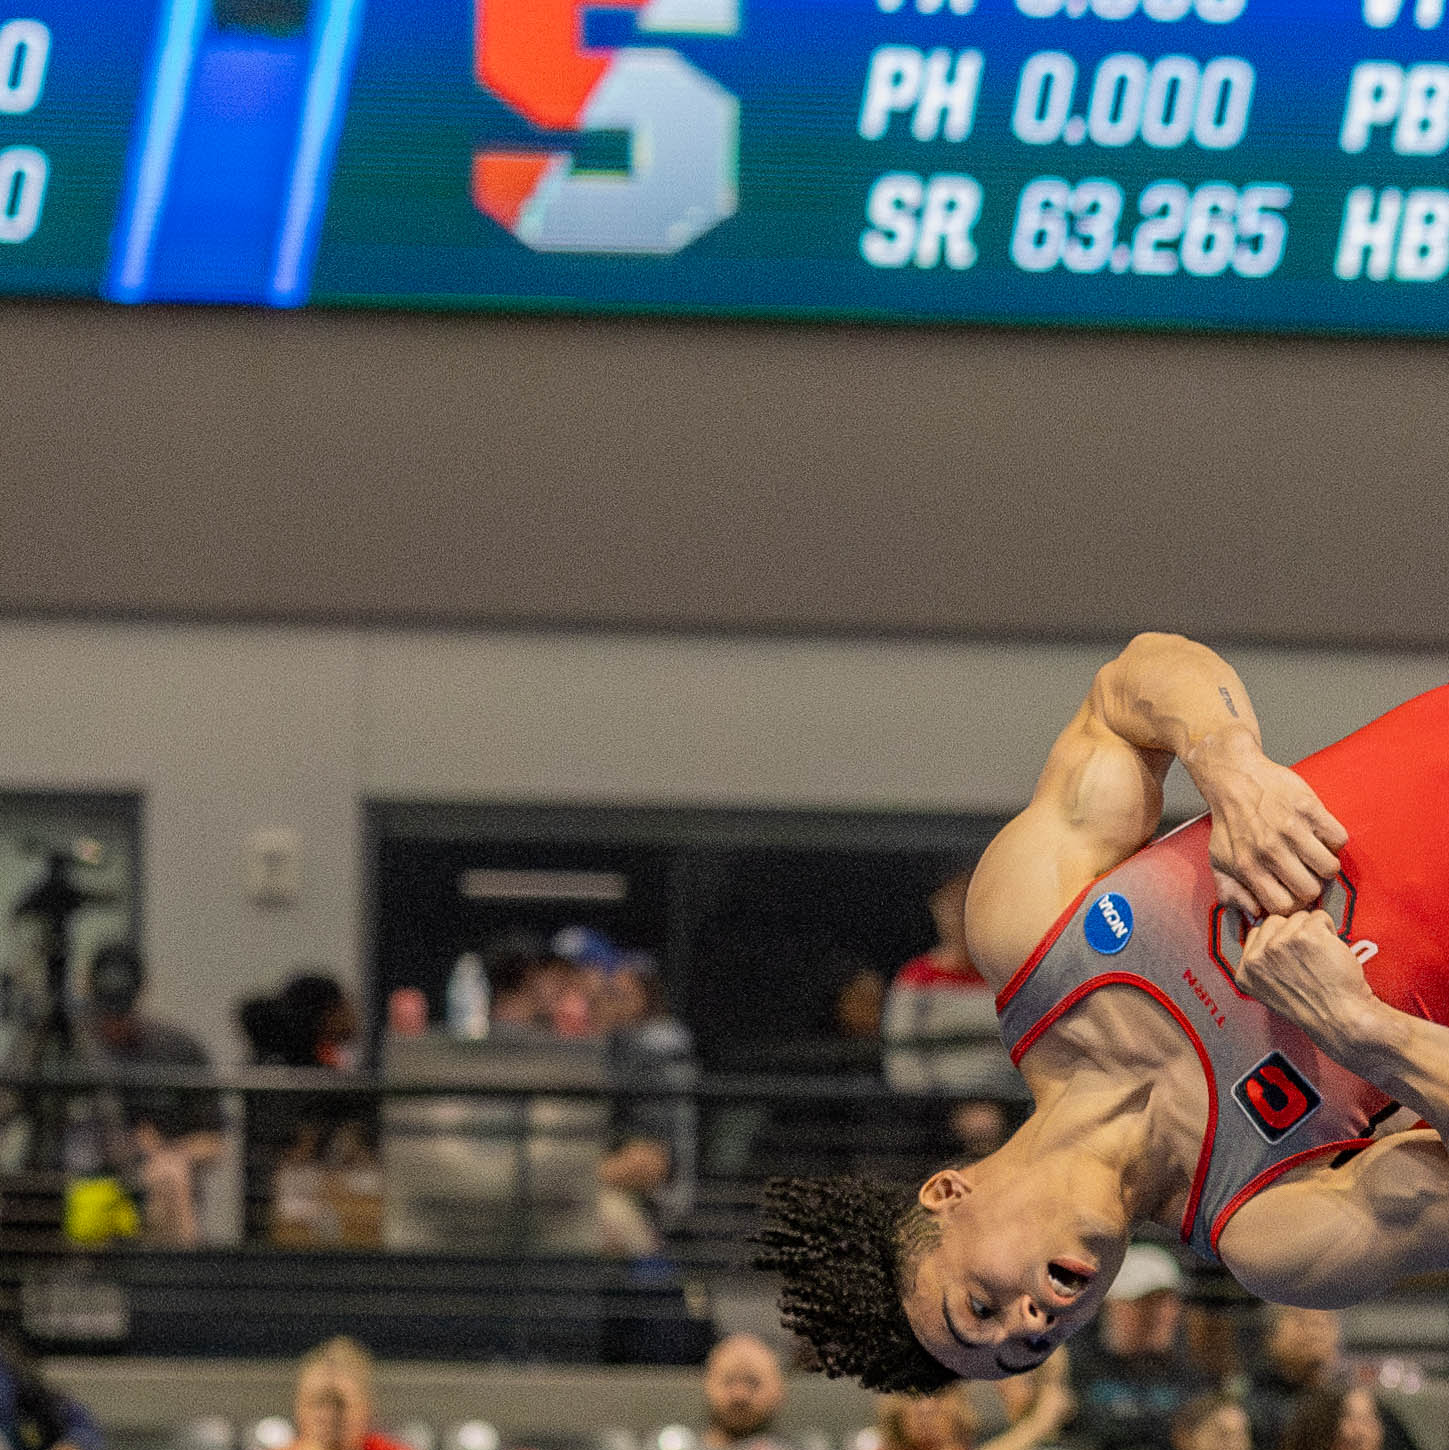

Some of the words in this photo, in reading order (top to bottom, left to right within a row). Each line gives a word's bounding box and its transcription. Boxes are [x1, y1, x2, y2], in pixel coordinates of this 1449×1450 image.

[858, 46, 984, 142] PH
[1012, 51, 1255, 148] 0.000
[860, 173, 983, 270] SR
[1010, 178, 1292, 277] 63.265
[1097, 894, 1129, 939] NCAA
